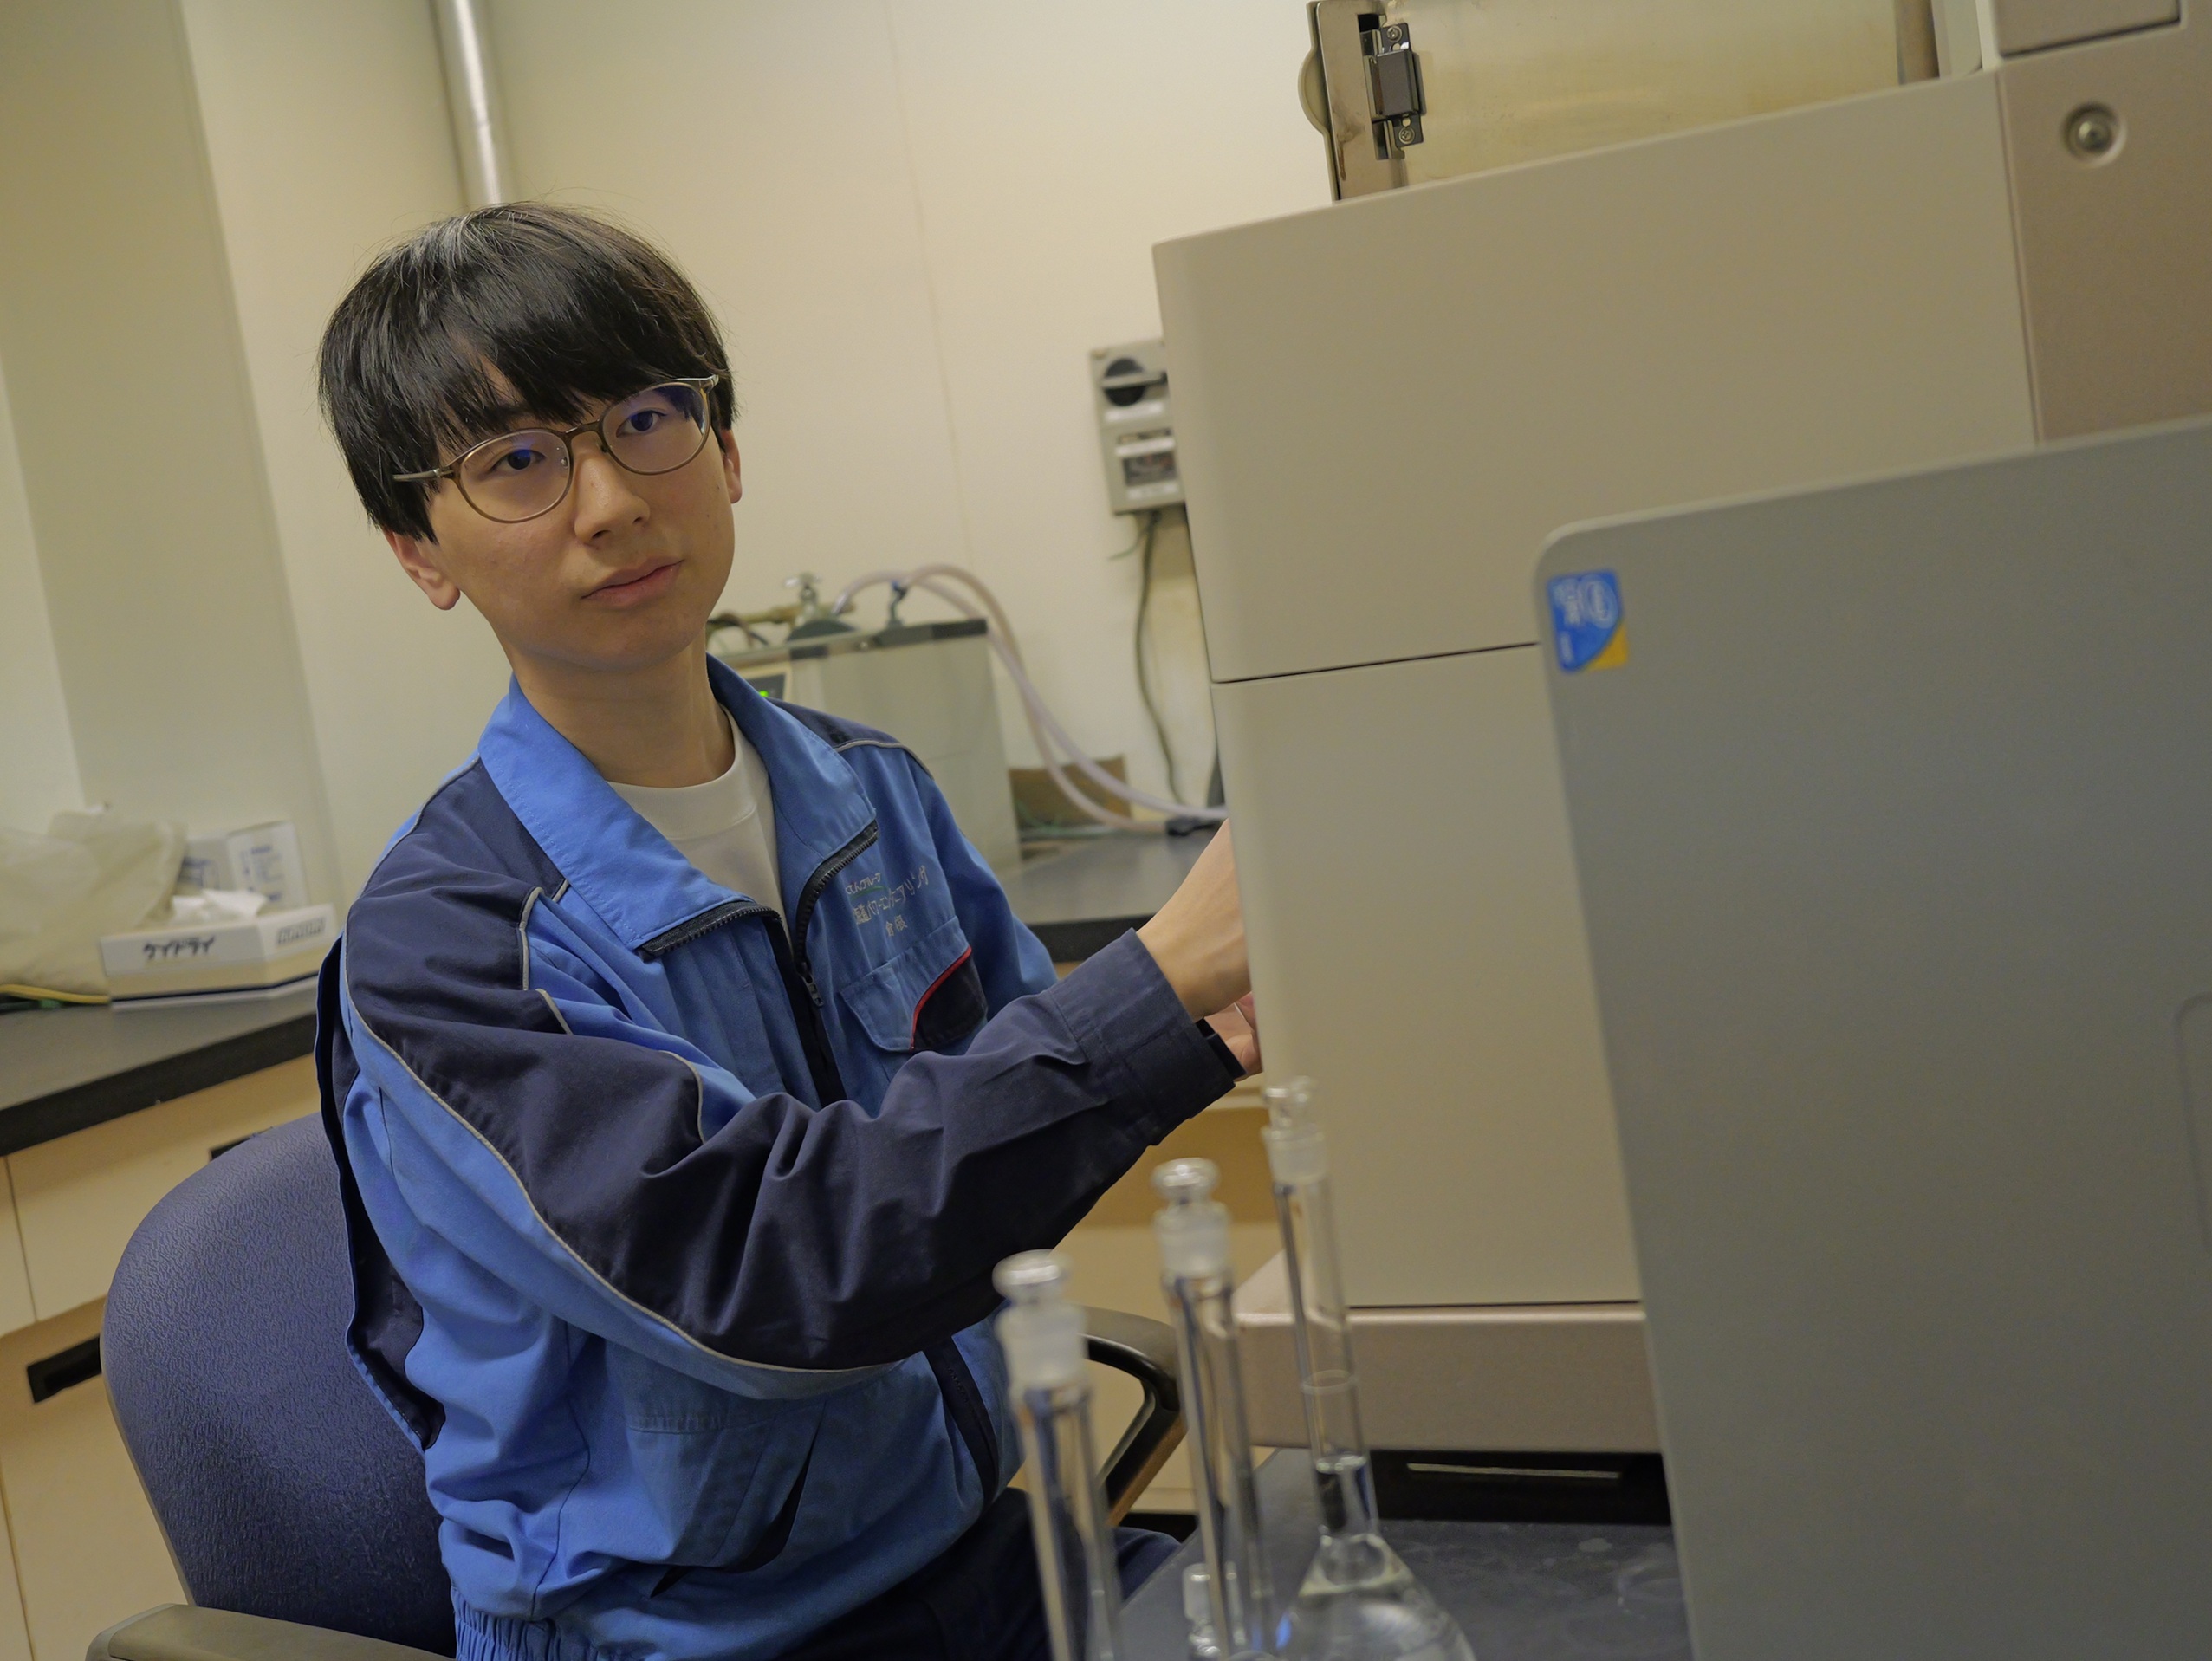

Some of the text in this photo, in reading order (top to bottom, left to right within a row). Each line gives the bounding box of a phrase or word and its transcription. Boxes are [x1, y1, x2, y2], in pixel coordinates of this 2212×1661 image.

[845, 873, 881, 895] くでんグループ
